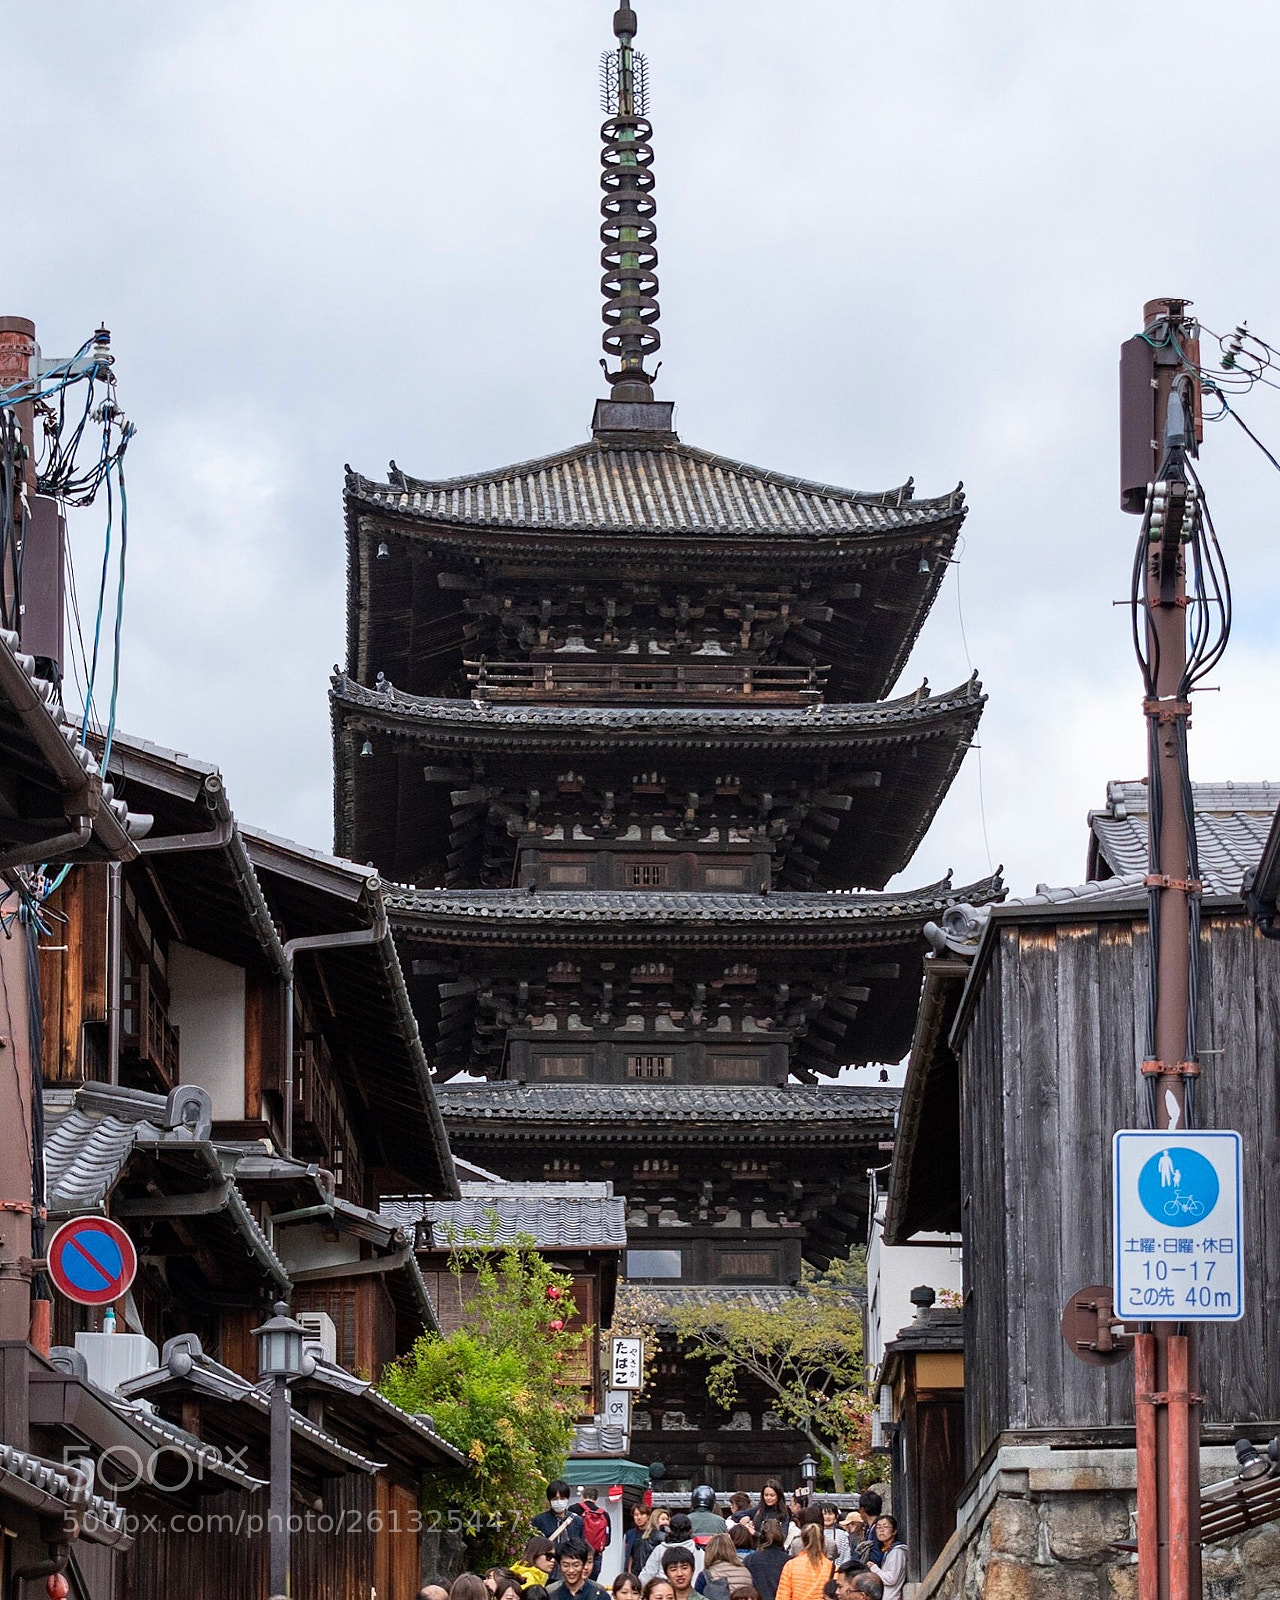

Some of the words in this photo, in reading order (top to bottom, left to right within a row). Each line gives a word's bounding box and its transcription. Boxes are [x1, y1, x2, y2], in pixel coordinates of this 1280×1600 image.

[1124, 1237, 1234, 1254] 土曜・日曜・休日
[1129, 1287, 1175, 1306] この先
[1185, 1286, 1231, 1307] 40m
[615, 1341, 628, 1384] たばこ
[629, 1348, 637, 1378] やさか
